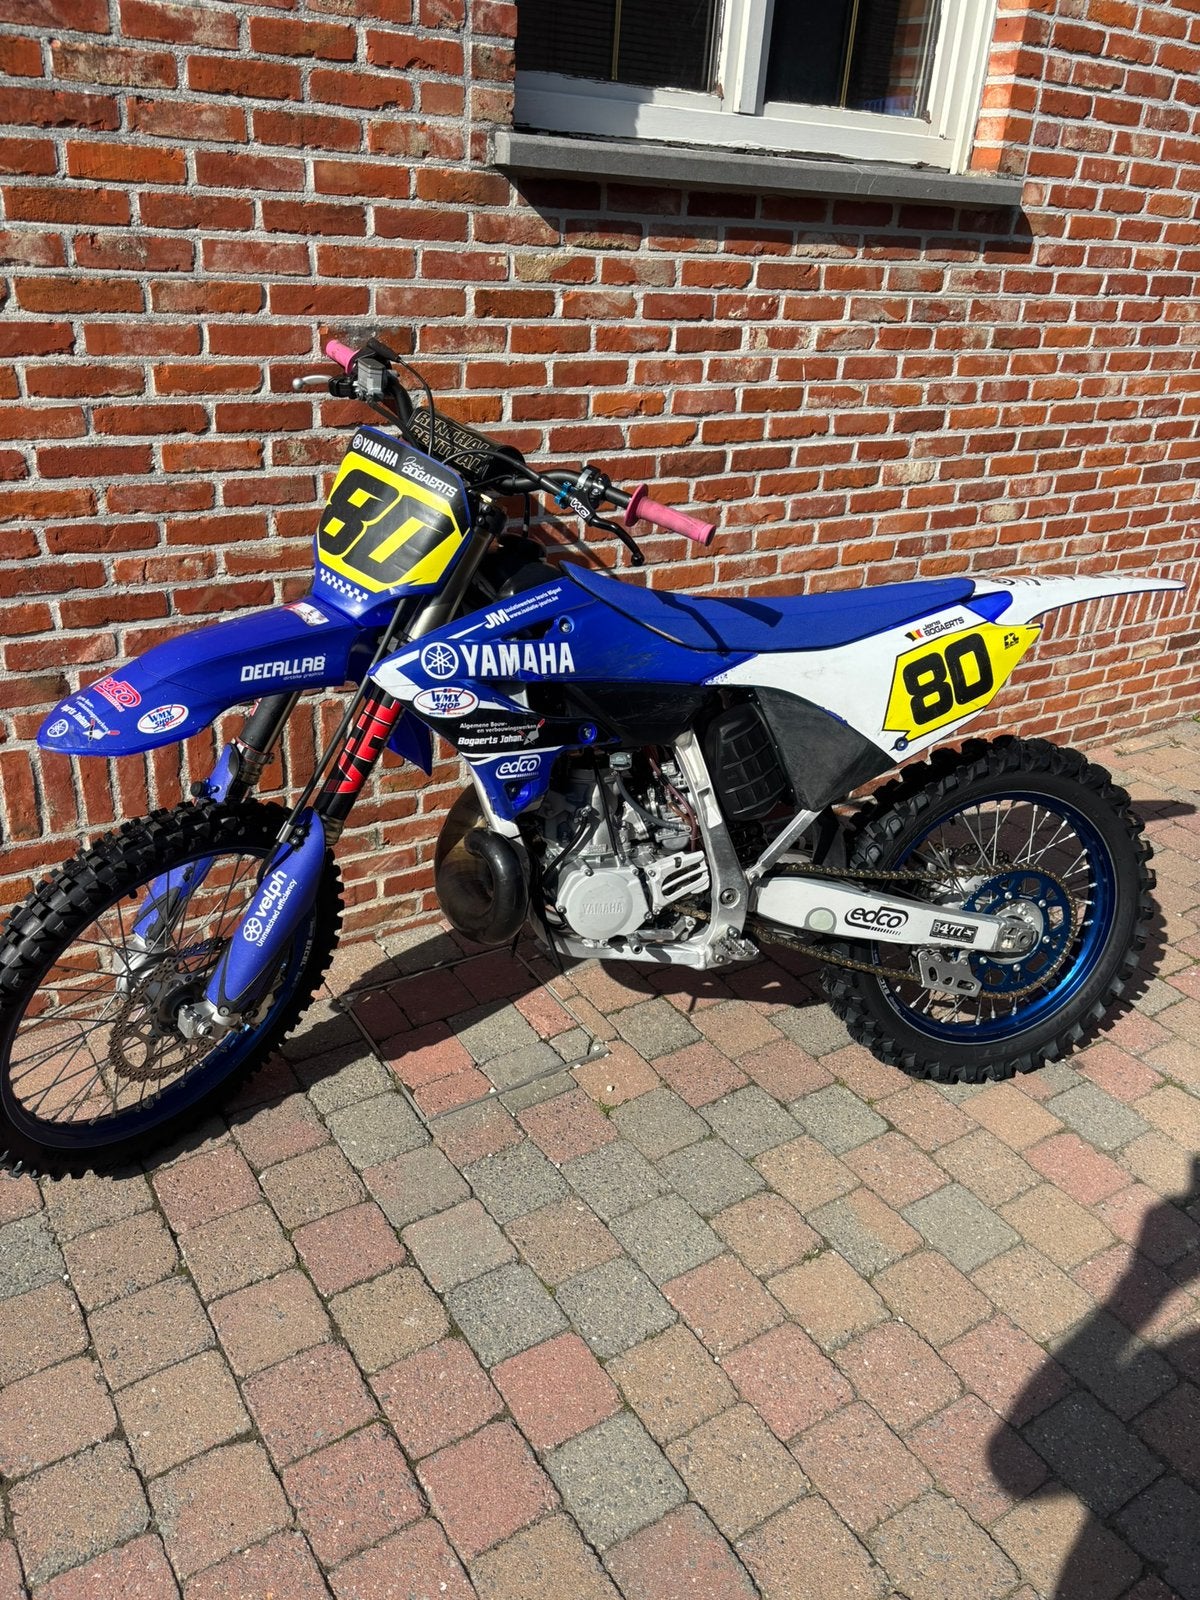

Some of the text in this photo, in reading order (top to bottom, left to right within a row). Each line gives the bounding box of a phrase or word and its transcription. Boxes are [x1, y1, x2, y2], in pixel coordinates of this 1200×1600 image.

[361, 437, 399, 468] YAMAHA
[401, 465, 458, 498] BOGAERTS
[318, 468, 456, 584] 80
[484, 608, 511, 629] JM
[924, 616, 965, 637] BOGAERTS
[240, 655, 326, 682] DECALLAB
[459, 642, 576, 677] YAMAHA
[902, 632, 994, 726] 80
[431, 689, 465, 703] WMX
[432, 702, 461, 711] SHOP
[460, 722, 489, 730] Algemene
[485, 724, 537, 733] verbouwingswerken
[458, 736, 498, 747] Bogaerts
[499, 755, 538, 774] edco
[255, 870, 288, 917] velph
[256, 879, 298, 948] Unmatched efficiency
[582, 902, 624, 915] YAMAHA
[850, 906, 903, 929] edco
